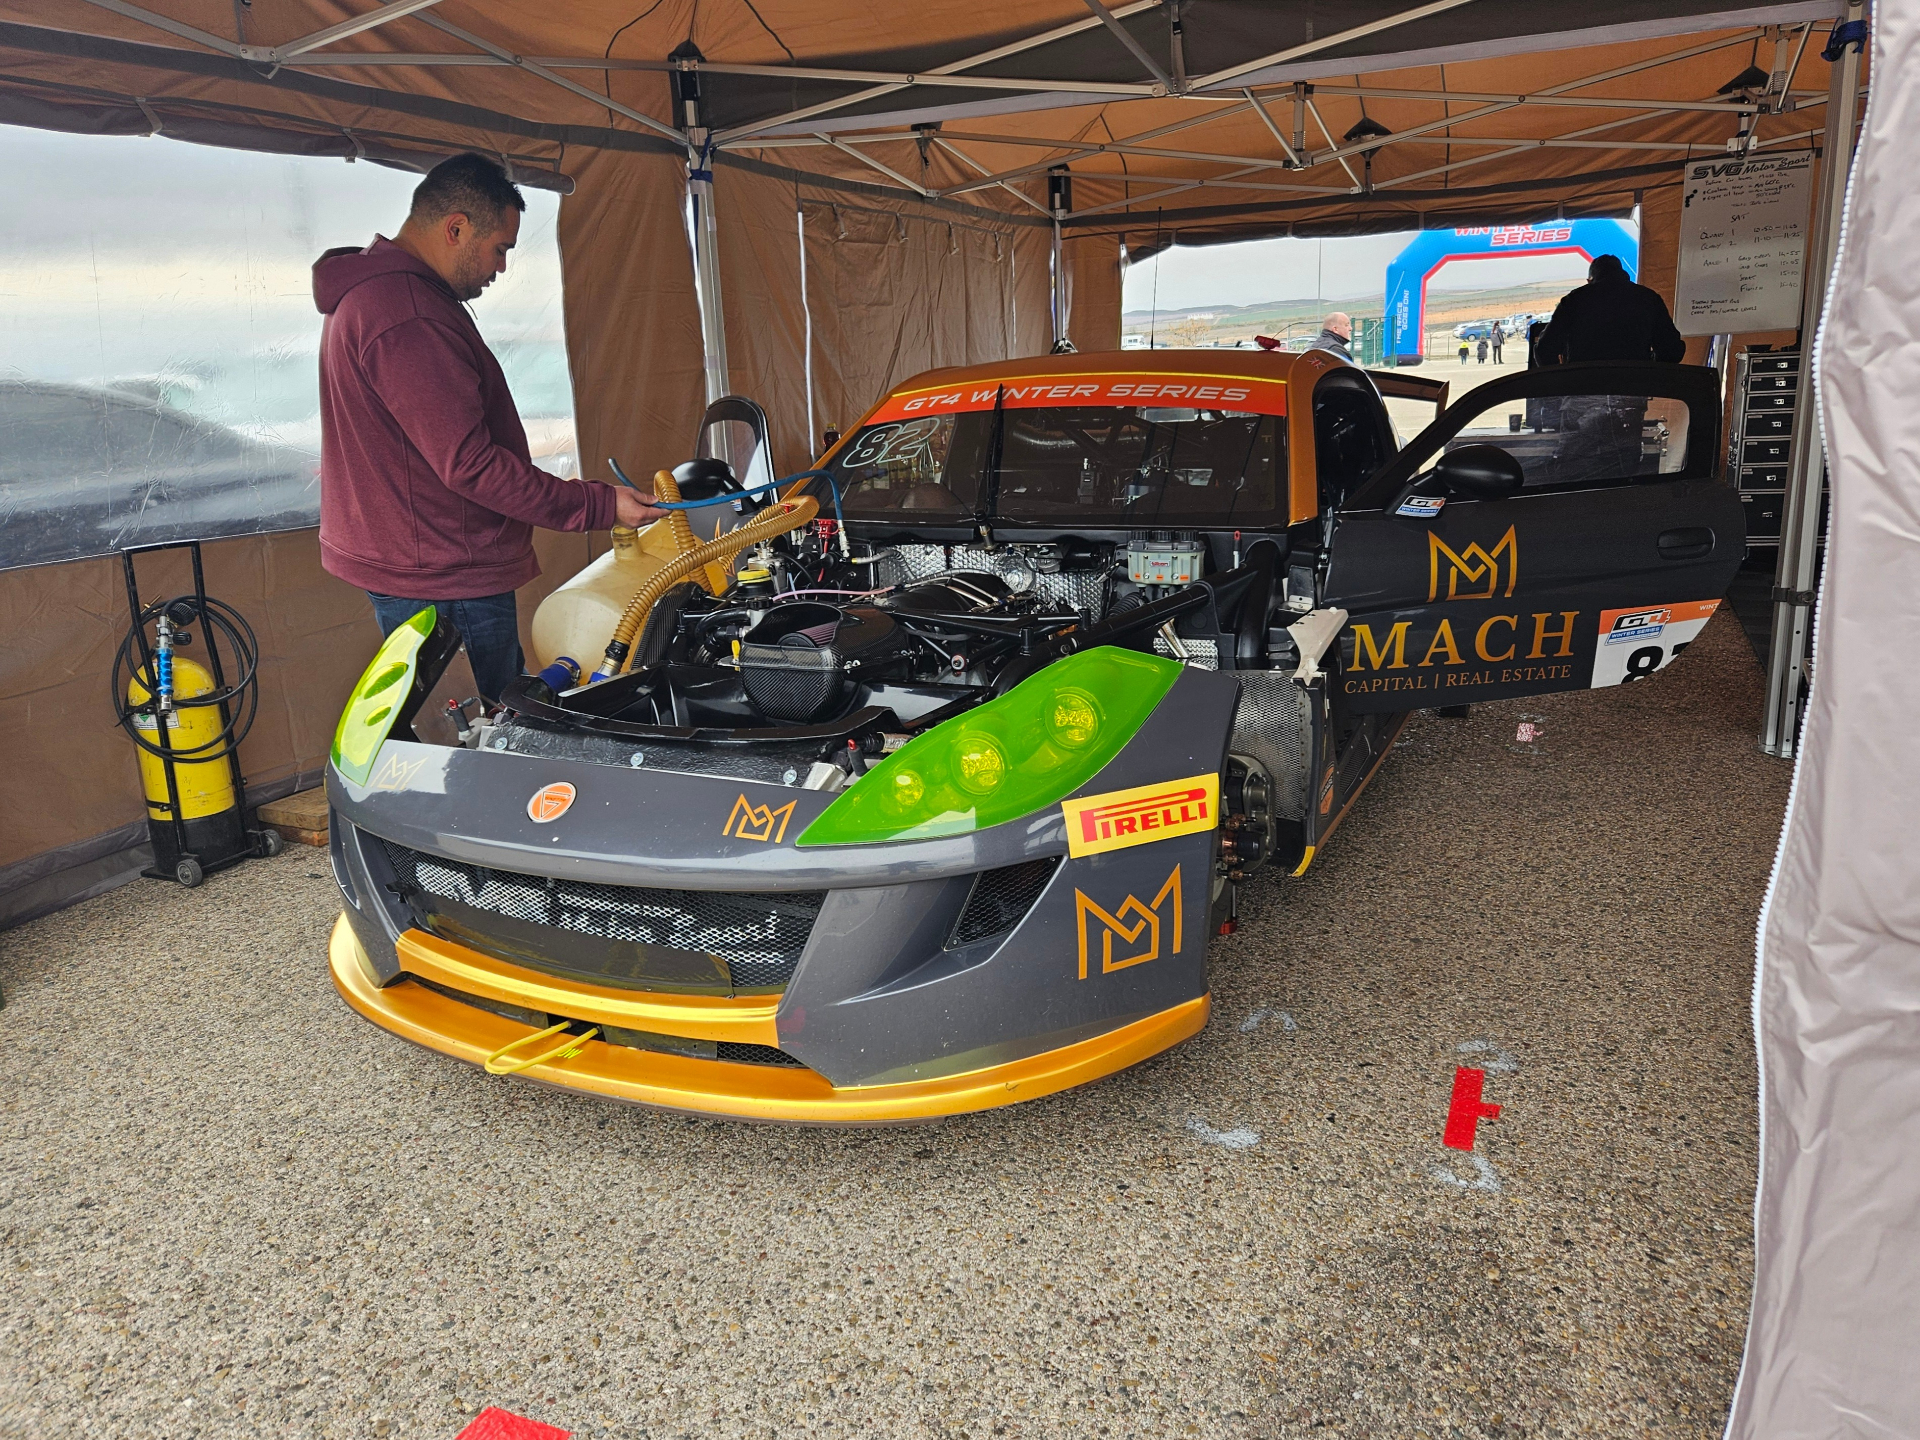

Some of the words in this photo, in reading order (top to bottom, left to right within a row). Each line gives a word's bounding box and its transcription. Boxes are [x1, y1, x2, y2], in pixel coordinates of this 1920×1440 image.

[1690, 162, 1745, 180] SVG
[1742, 163, 1775, 175] Motor
[1779, 153, 1811, 169] Sport
[1491, 228, 1571, 246] SERIES
[903, 392, 960, 411] GT4
[1107, 383, 1252, 402] SERIES
[842, 417, 941, 468] 82
[1611, 630, 1635, 639] WINTER
[1636, 626, 1660, 635] SERIES
[1619, 610, 1670, 629] GT4
[1346, 610, 1580, 672] MACH
[1345, 675, 1428, 694] CAPITAL
[1445, 670, 1495, 688] REAL
[1501, 664, 1572, 683] ESTATE
[1079, 788, 1208, 843] PIRELLI
